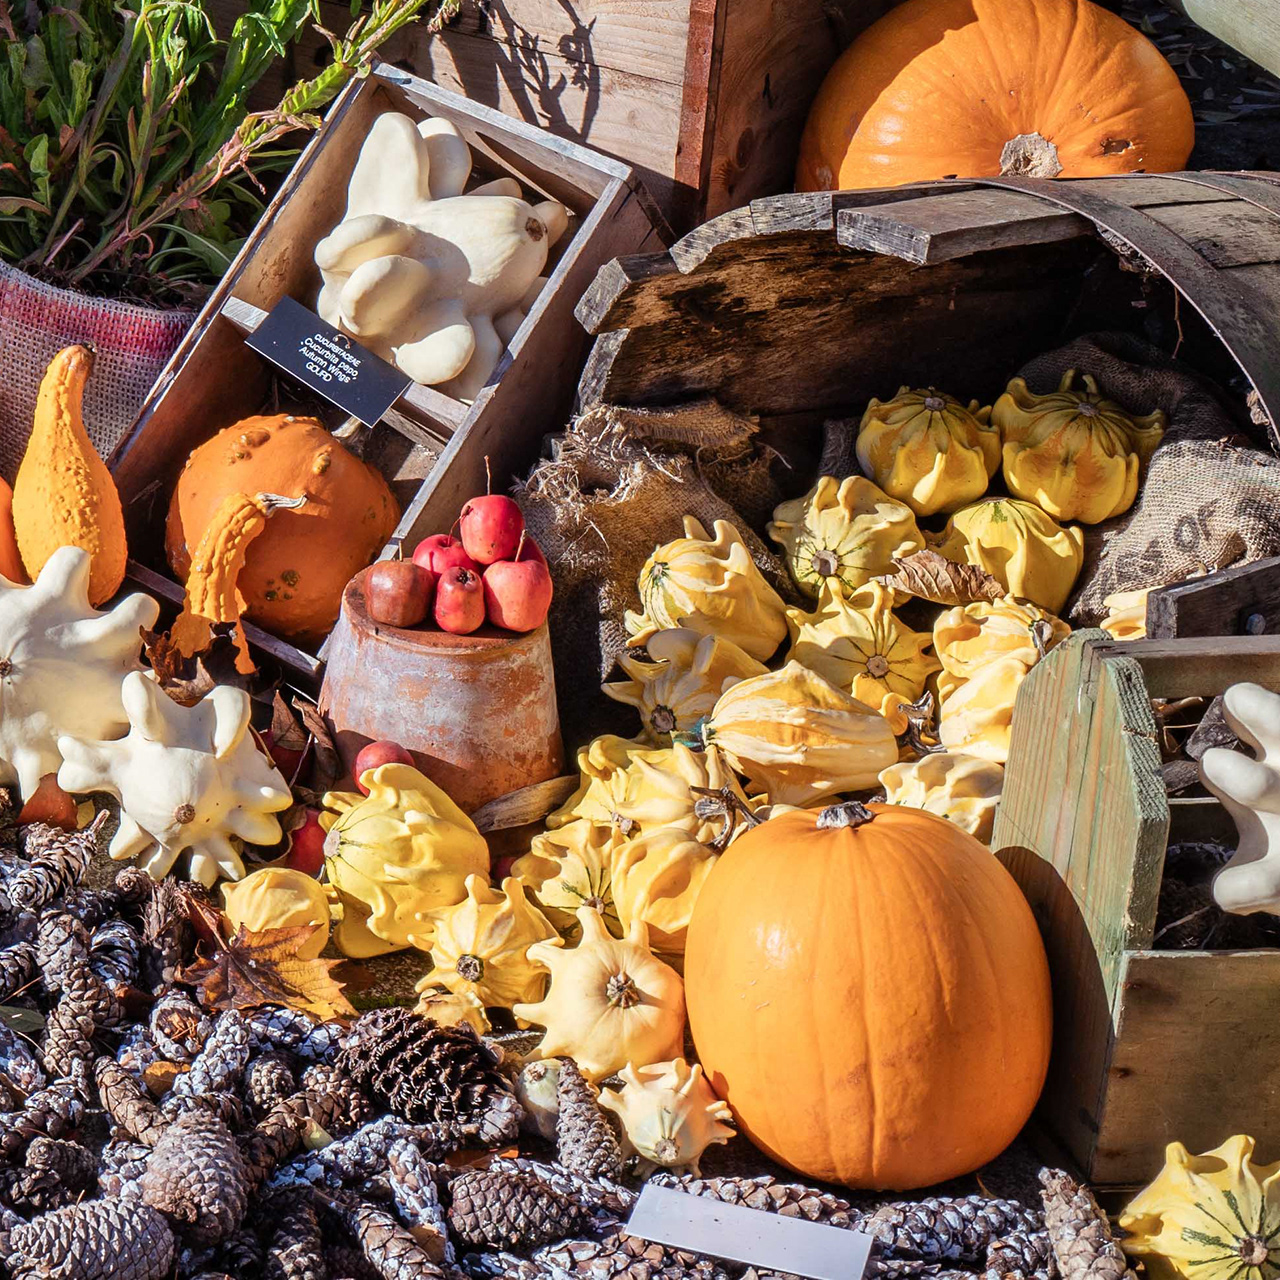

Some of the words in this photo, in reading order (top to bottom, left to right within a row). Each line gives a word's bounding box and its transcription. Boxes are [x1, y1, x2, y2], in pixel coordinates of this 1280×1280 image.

[304, 337, 339, 364] Cucurbita
[338, 360, 359, 378] pepo
[314, 333, 362, 368] CUCURBITACEAE
[305, 362, 333, 382] GOURD
